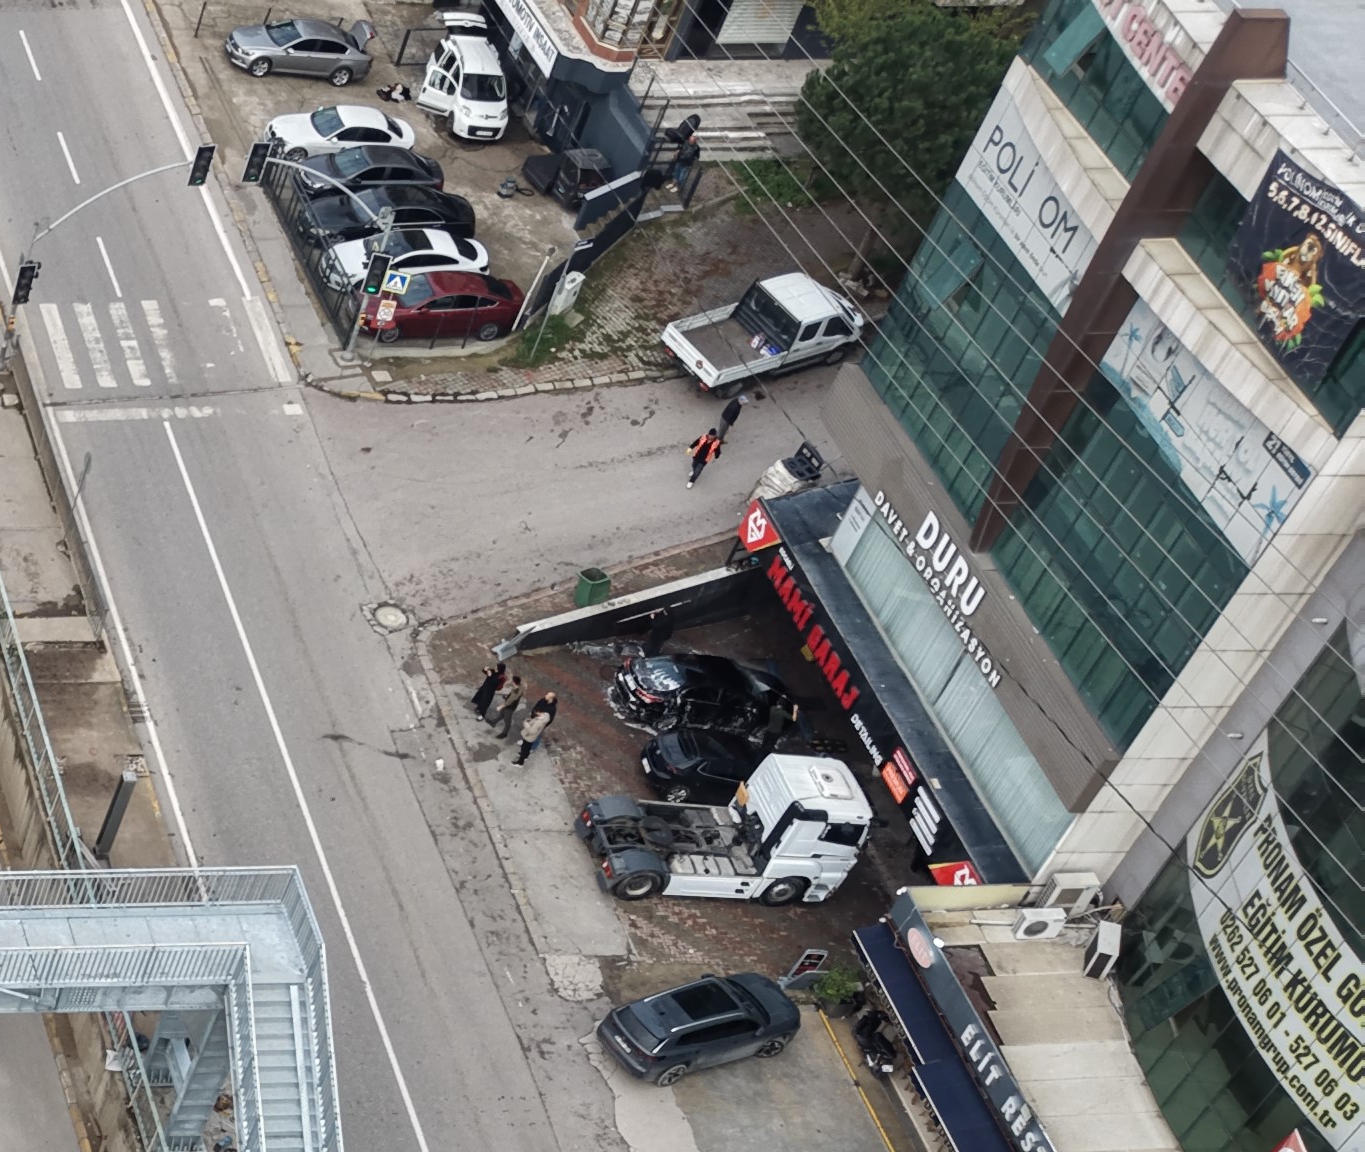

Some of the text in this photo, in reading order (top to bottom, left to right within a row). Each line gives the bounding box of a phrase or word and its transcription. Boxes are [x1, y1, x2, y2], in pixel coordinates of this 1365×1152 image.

[874, 490, 908, 543] DAVET
[915, 510, 987, 616] DURU
[766, 555, 860, 711] MAMİ GARAJ
[850, 712, 885, 768] DETAILING
[1241, 888, 1294, 979] EĞİTİM
[1253, 812, 1308, 923] PRONAM
[1296, 907, 1342, 984] ÖZEL
[1208, 933, 1337, 1131] www.pronamgrup.com.tr
[1219, 907, 1243, 953] 0262
[1235, 945, 1260, 981] 527
[1253, 978, 1273, 1006] 06
[1266, 1000, 1286, 1029] 01
[1289, 1034, 1319, 1072] 527
[1314, 1069, 1339, 1100] 06
[1335, 1091, 1360, 1123] 03
